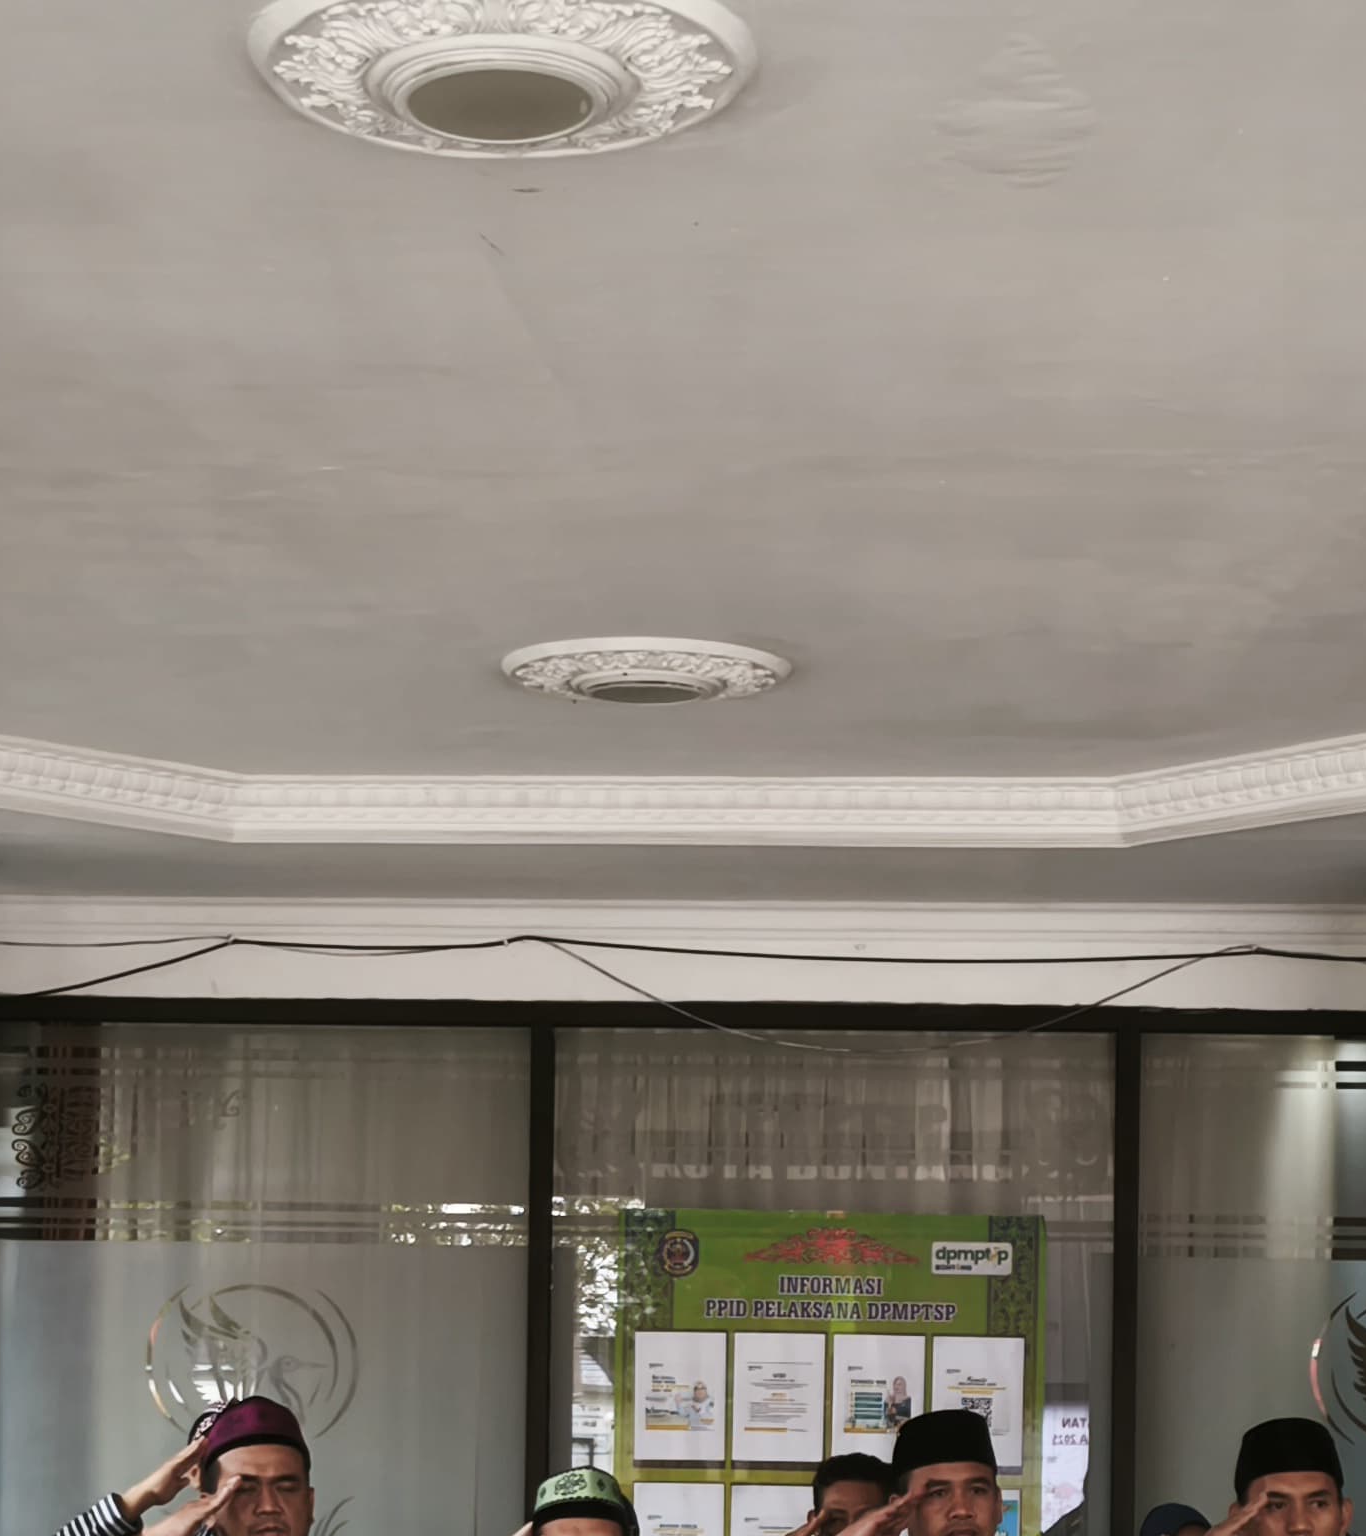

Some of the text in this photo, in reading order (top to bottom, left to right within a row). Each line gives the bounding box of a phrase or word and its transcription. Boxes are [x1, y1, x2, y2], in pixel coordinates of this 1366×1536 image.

[779, 1275, 884, 1296] INFORMASI
[704, 1299, 957, 1322] PPID PELAKSANA DPMPTSP
